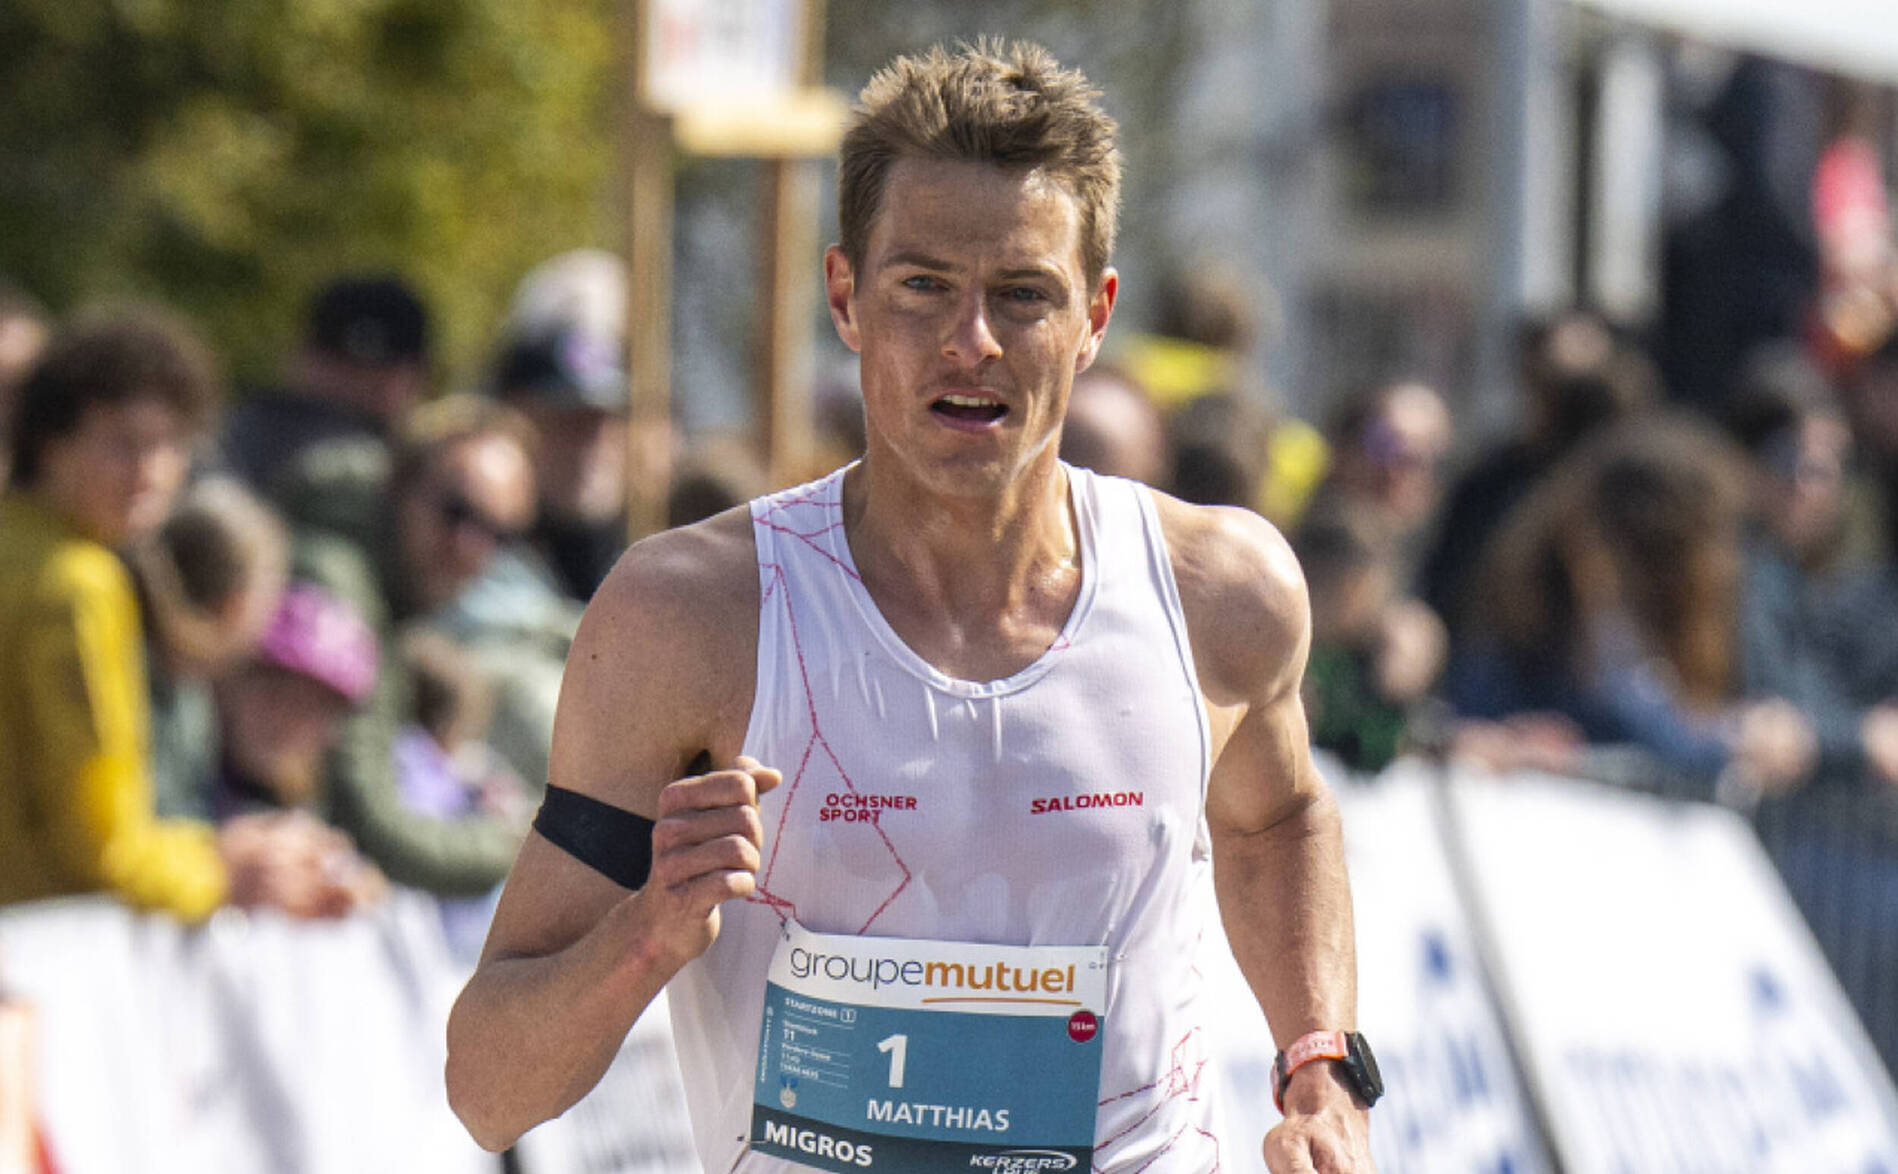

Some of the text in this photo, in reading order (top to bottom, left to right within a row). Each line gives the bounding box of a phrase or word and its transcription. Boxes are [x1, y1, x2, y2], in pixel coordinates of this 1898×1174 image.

[826, 793, 917, 810] OCHSNER
[1031, 792, 1143, 814] SALOMON
[820, 808, 882, 824] SPORT
[878, 1034, 908, 1089] 1
[866, 1099, 1011, 1132] MATTHIAS
[765, 1120, 873, 1167] MIGROS
